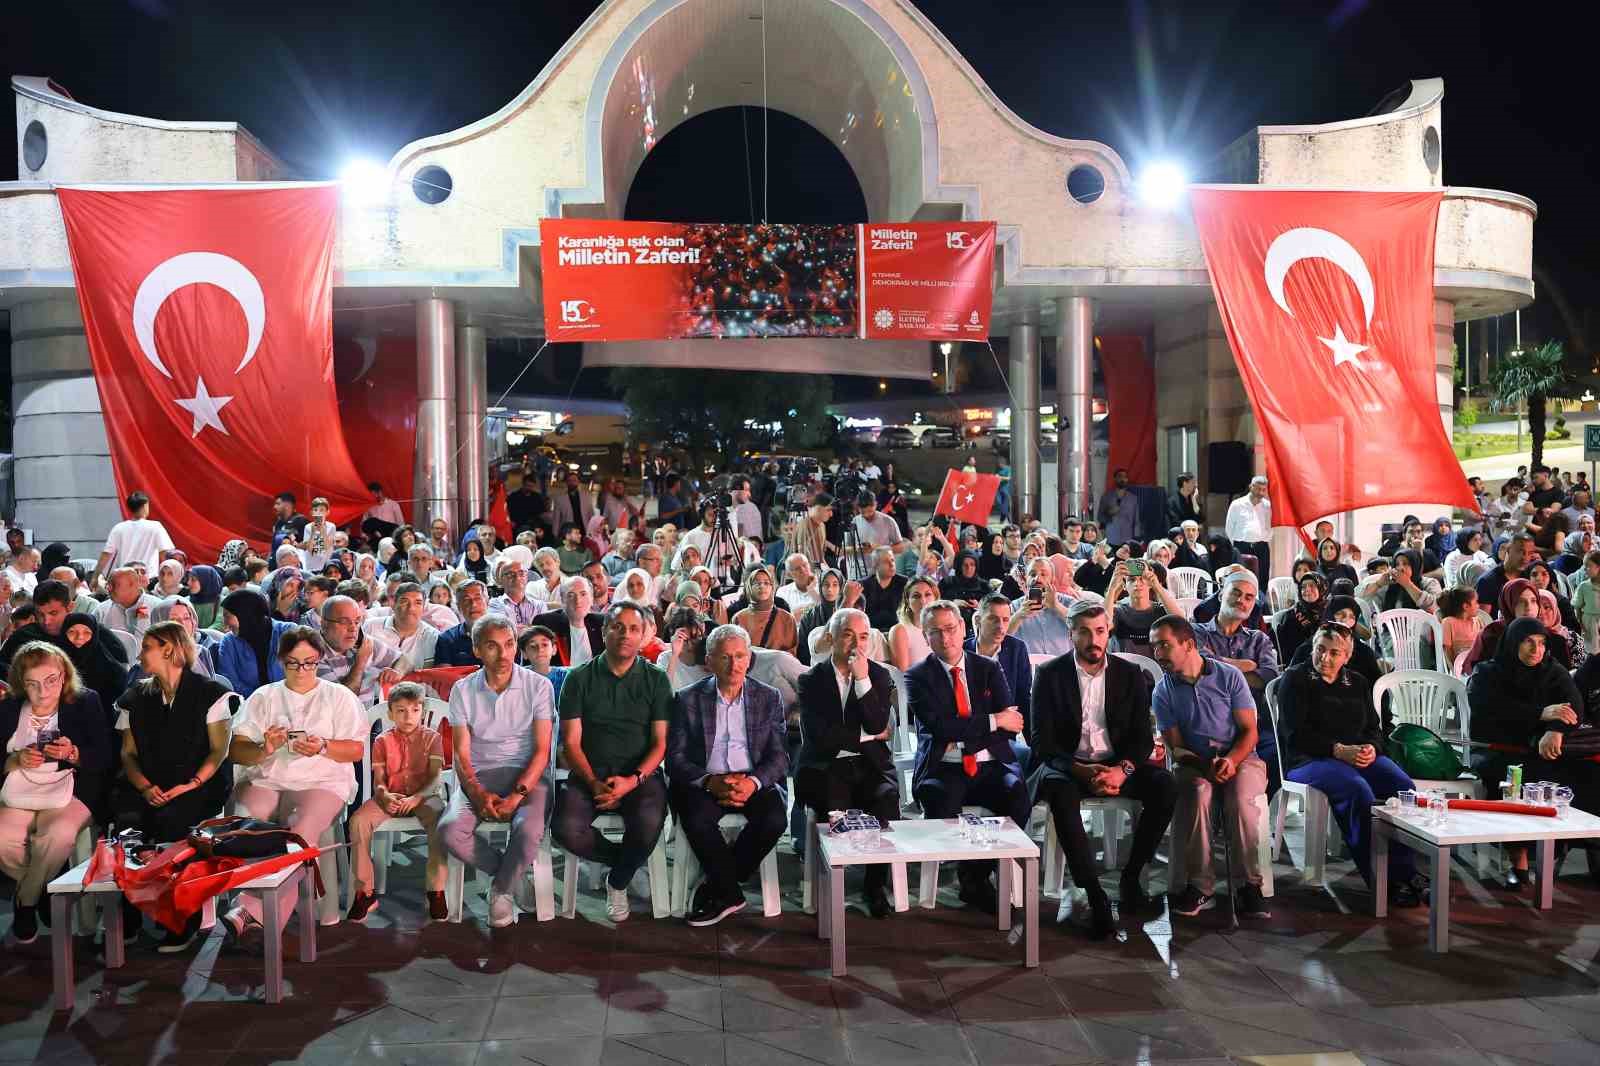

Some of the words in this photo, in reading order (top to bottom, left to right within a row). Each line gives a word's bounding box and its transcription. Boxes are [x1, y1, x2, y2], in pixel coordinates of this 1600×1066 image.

[871, 229, 917, 240] Milletin
[559, 235, 624, 249] Karanlığa
[628, 235, 651, 249] ışık
[654, 236, 684, 247] olan
[872, 240, 913, 250] Zaferi!
[559, 248, 631, 266] Milletin
[635, 248, 701, 265] Zaferi!
[560, 300, 583, 323] 15
